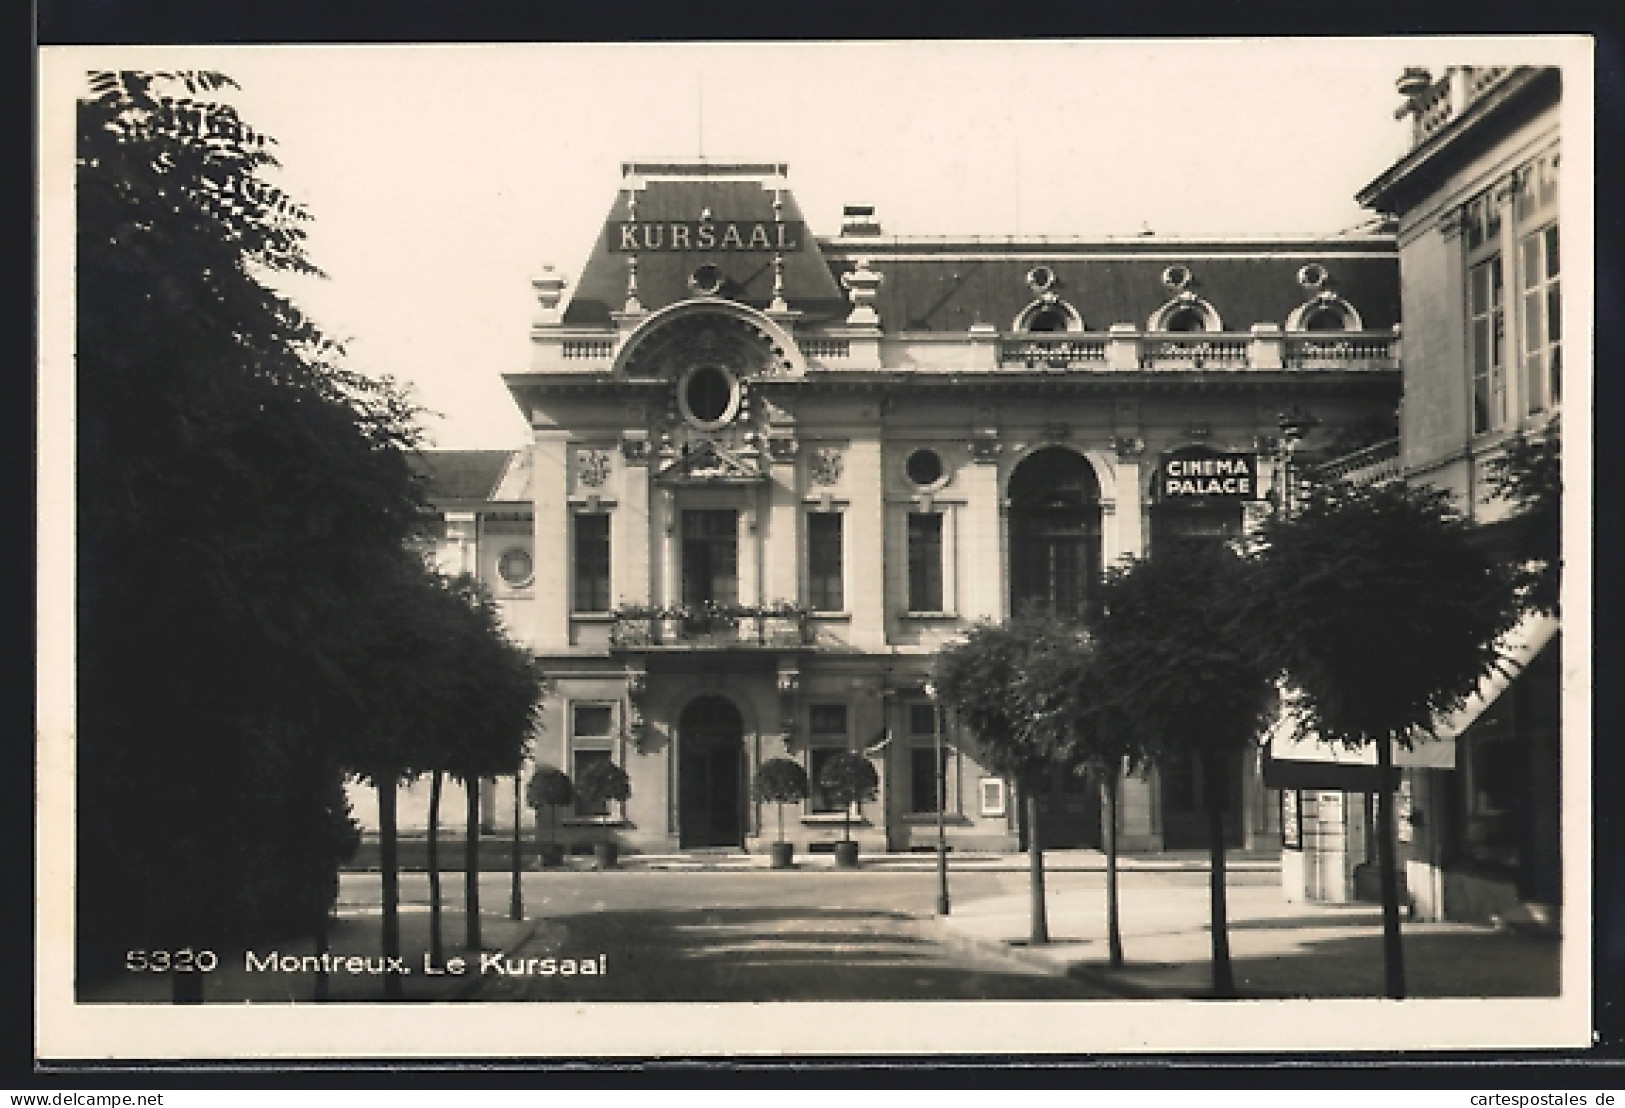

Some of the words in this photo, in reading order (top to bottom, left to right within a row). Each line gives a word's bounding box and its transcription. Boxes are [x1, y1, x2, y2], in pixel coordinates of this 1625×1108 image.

[619, 223, 797, 250] KURSAAL
[1166, 459, 1250, 476] CINEMA
[1165, 478, 1250, 494] PALACE
